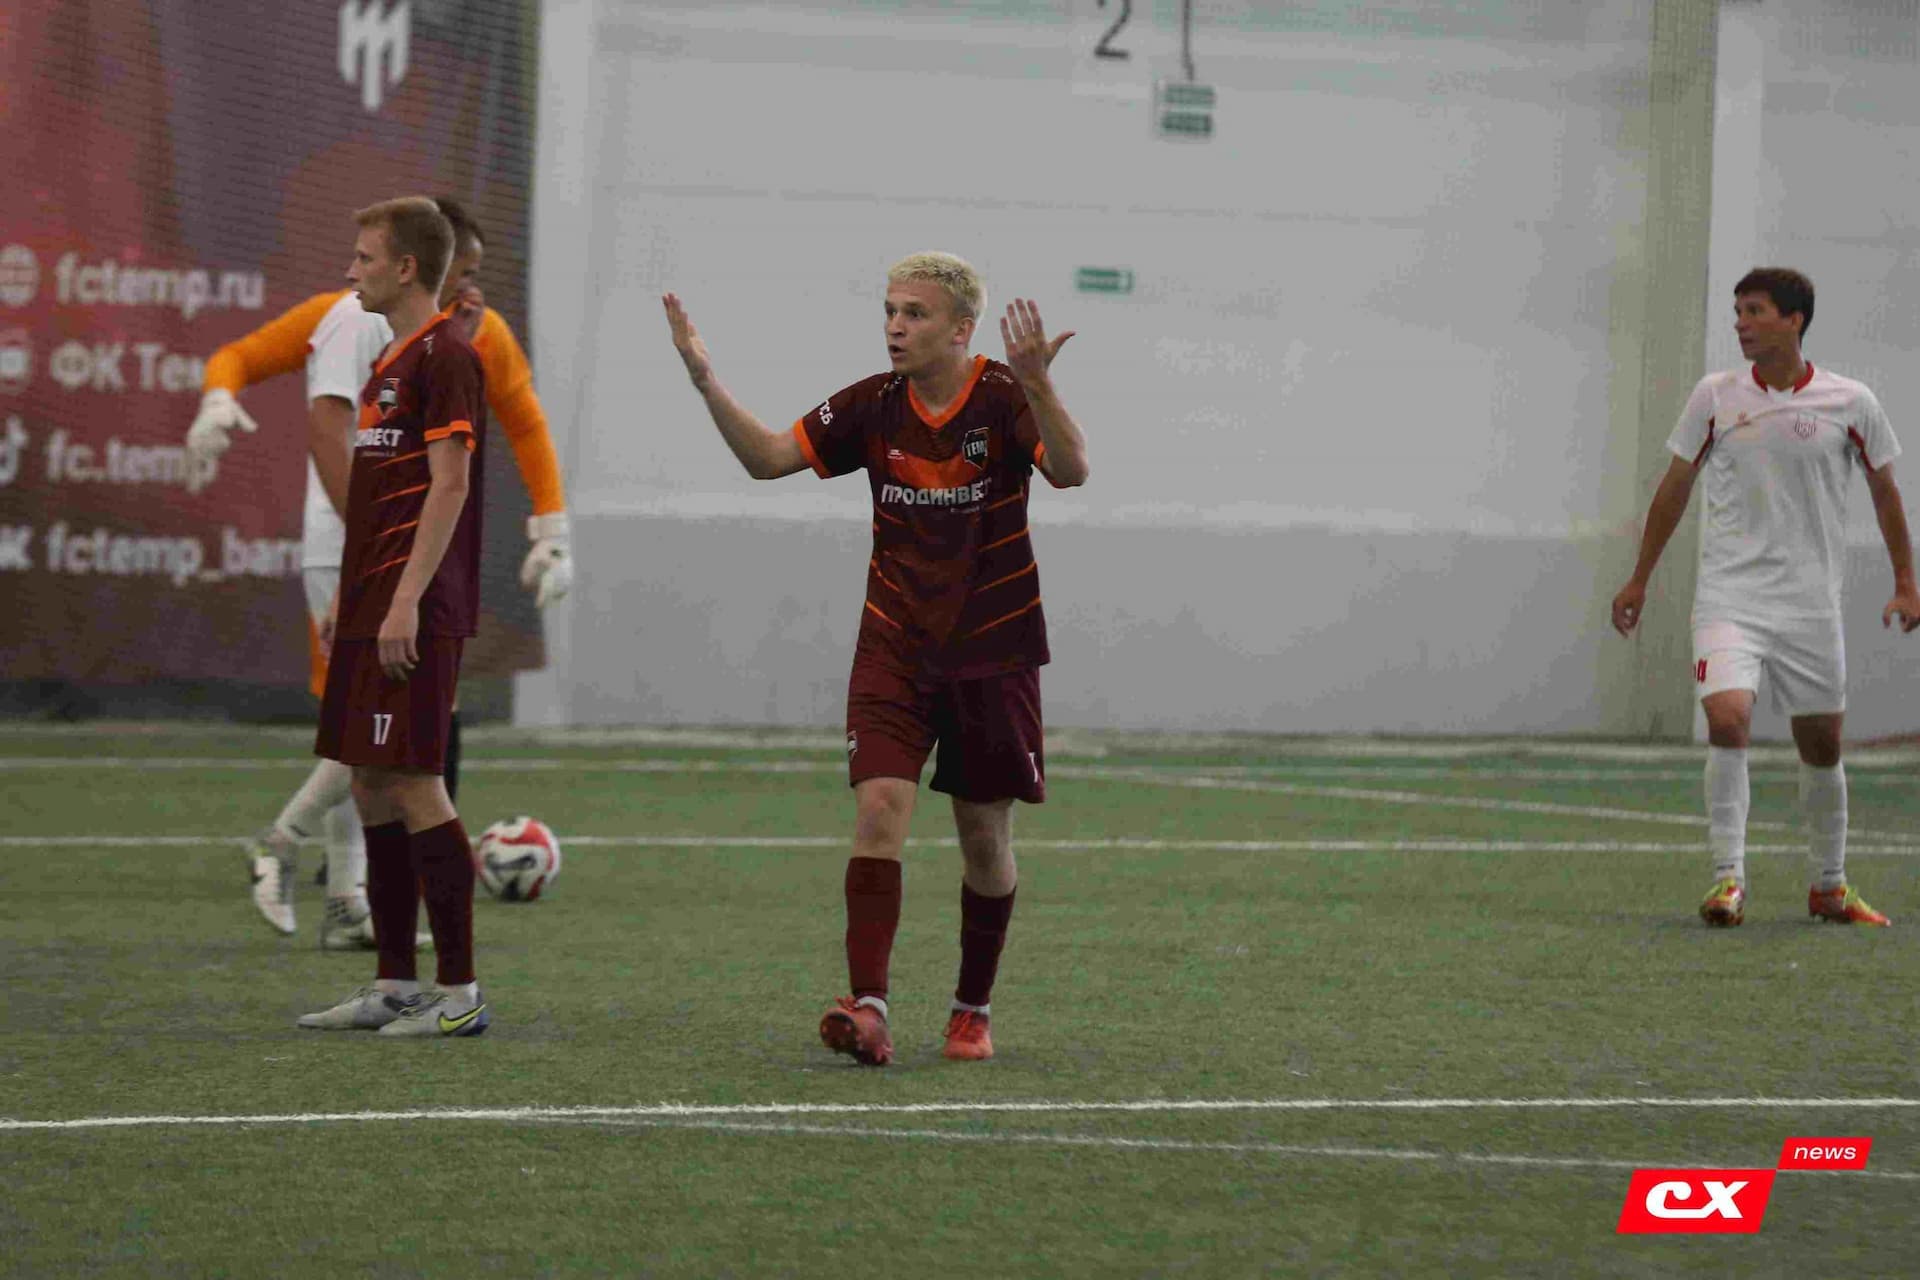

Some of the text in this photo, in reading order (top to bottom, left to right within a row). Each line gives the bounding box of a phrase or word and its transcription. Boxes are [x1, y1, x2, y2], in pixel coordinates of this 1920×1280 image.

[56, 252, 265, 319] fctemp.ru
[51, 340, 126, 391] ФК
[373, 713, 393, 745] 17
